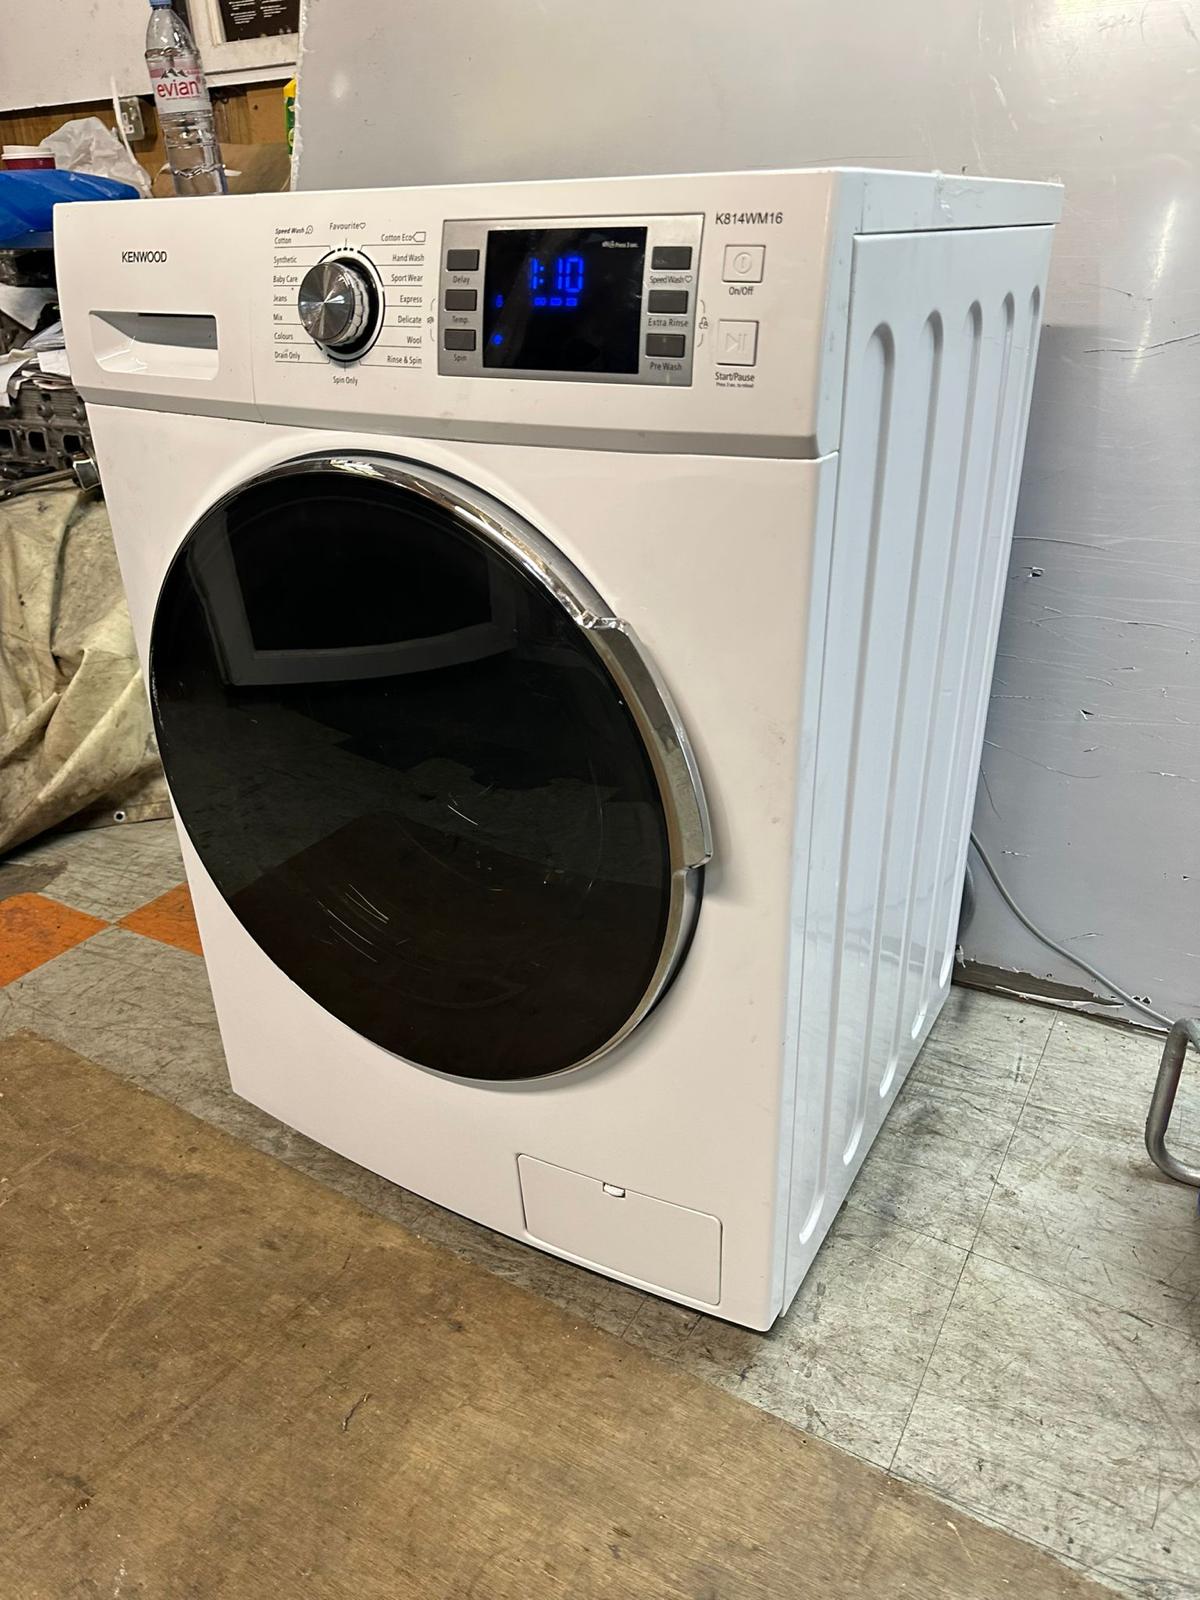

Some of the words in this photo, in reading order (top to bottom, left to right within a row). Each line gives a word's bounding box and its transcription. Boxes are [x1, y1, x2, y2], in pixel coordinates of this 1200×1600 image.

[157, 79, 201, 97] evian
[715, 212, 783, 225] K814WM16
[329, 222, 360, 231] Favourite
[275, 227, 290, 236] Speed
[274, 236, 292, 244] Cotton
[381, 233, 401, 242] Cotton
[402, 233, 413, 242] Eco
[121, 250, 168, 263] KENWOOD
[273, 256, 298, 265] Synthetic
[392, 253, 408, 262] Hand
[408, 253, 425, 262] Wash
[391, 273, 408, 283] Sport
[408, 273, 424, 282] Wear
[530, 255, 584, 293] 1:10
[273, 275, 285, 284] Baby
[286, 275, 298, 283] Care
[452, 275, 470, 285] Delay
[650, 275, 667, 284] Speed
[667, 275, 685, 284] Wash
[728, 286, 754, 296] On/Off
[273, 294, 287, 302] Jeans
[399, 294, 423, 304] Express
[273, 313, 283, 321] Mix
[397, 315, 422, 324] Delicate
[648, 318, 667, 327] Extra
[668, 318, 689, 328] Rinse
[274, 332, 294, 340] Colours
[406, 336, 422, 344] Wool
[274, 351, 288, 359] Drain
[289, 352, 301, 360] Only
[387, 355, 403, 364] Rinse
[403, 356, 409, 364] &
[409, 356, 422, 365] Spin
[453, 354, 467, 362] Spin
[649, 361, 663, 370] Pre
[663, 361, 682, 371] Wash
[333, 375, 345, 385] Spin
[345, 376, 359, 386] Only
[715, 371, 755, 382] Start/Pause
